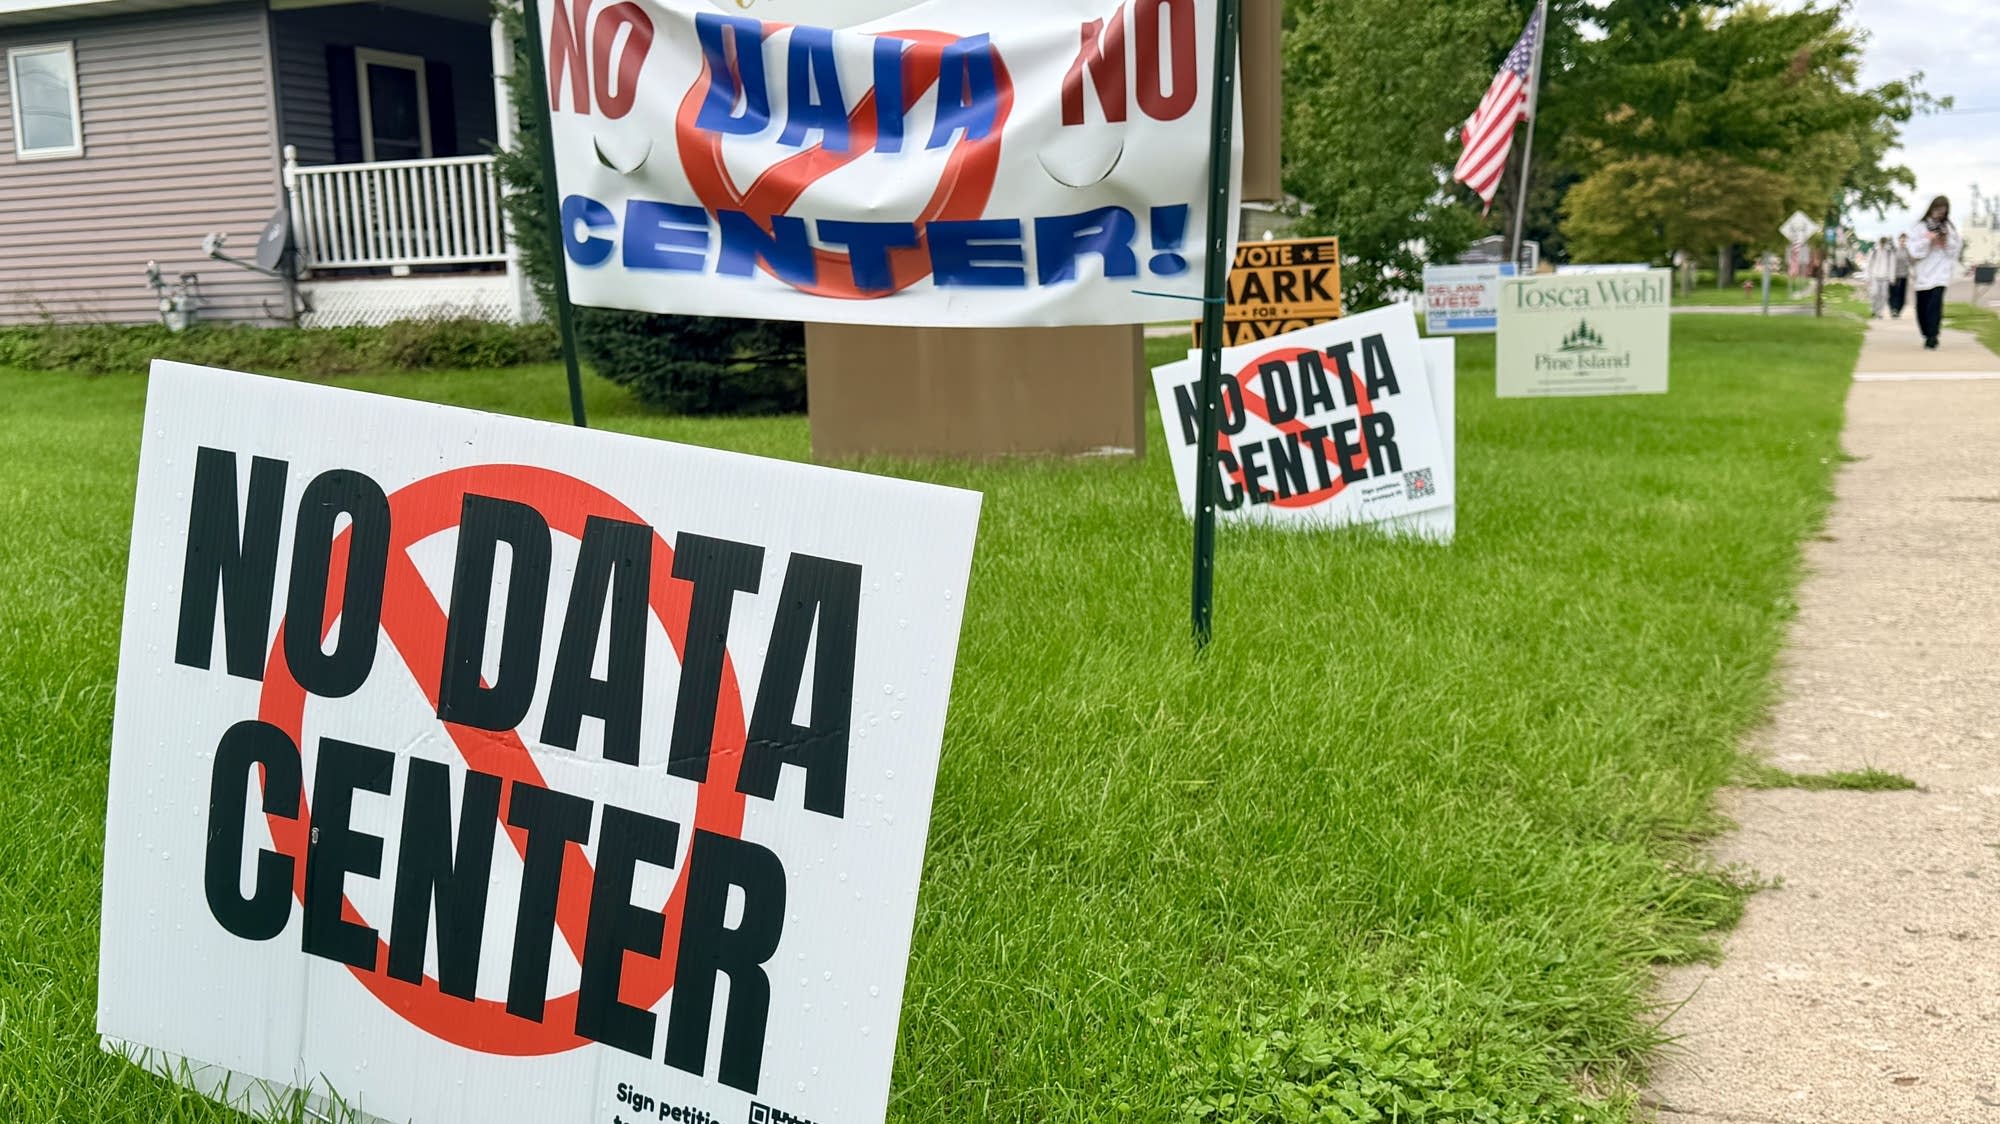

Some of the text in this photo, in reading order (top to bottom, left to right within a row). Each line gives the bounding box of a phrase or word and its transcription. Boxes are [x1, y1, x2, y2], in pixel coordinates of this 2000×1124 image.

[548, 0, 1198, 153] NO DATA NO
[561, 194, 1189, 290] CENTER!
[1236, 246, 1293, 268] VOTE
[1252, 308, 1277, 318] FOR
[1502, 279, 1589, 308] Tosca
[1173, 333, 1400, 446] NO DATA
[1535, 352, 1630, 371] Pine Island
[1216, 411, 1403, 511] CENTER
[175, 446, 863, 818] NO DATA
[203, 720, 787, 1095] CENTER
[616, 1082, 655, 1112] Sign
